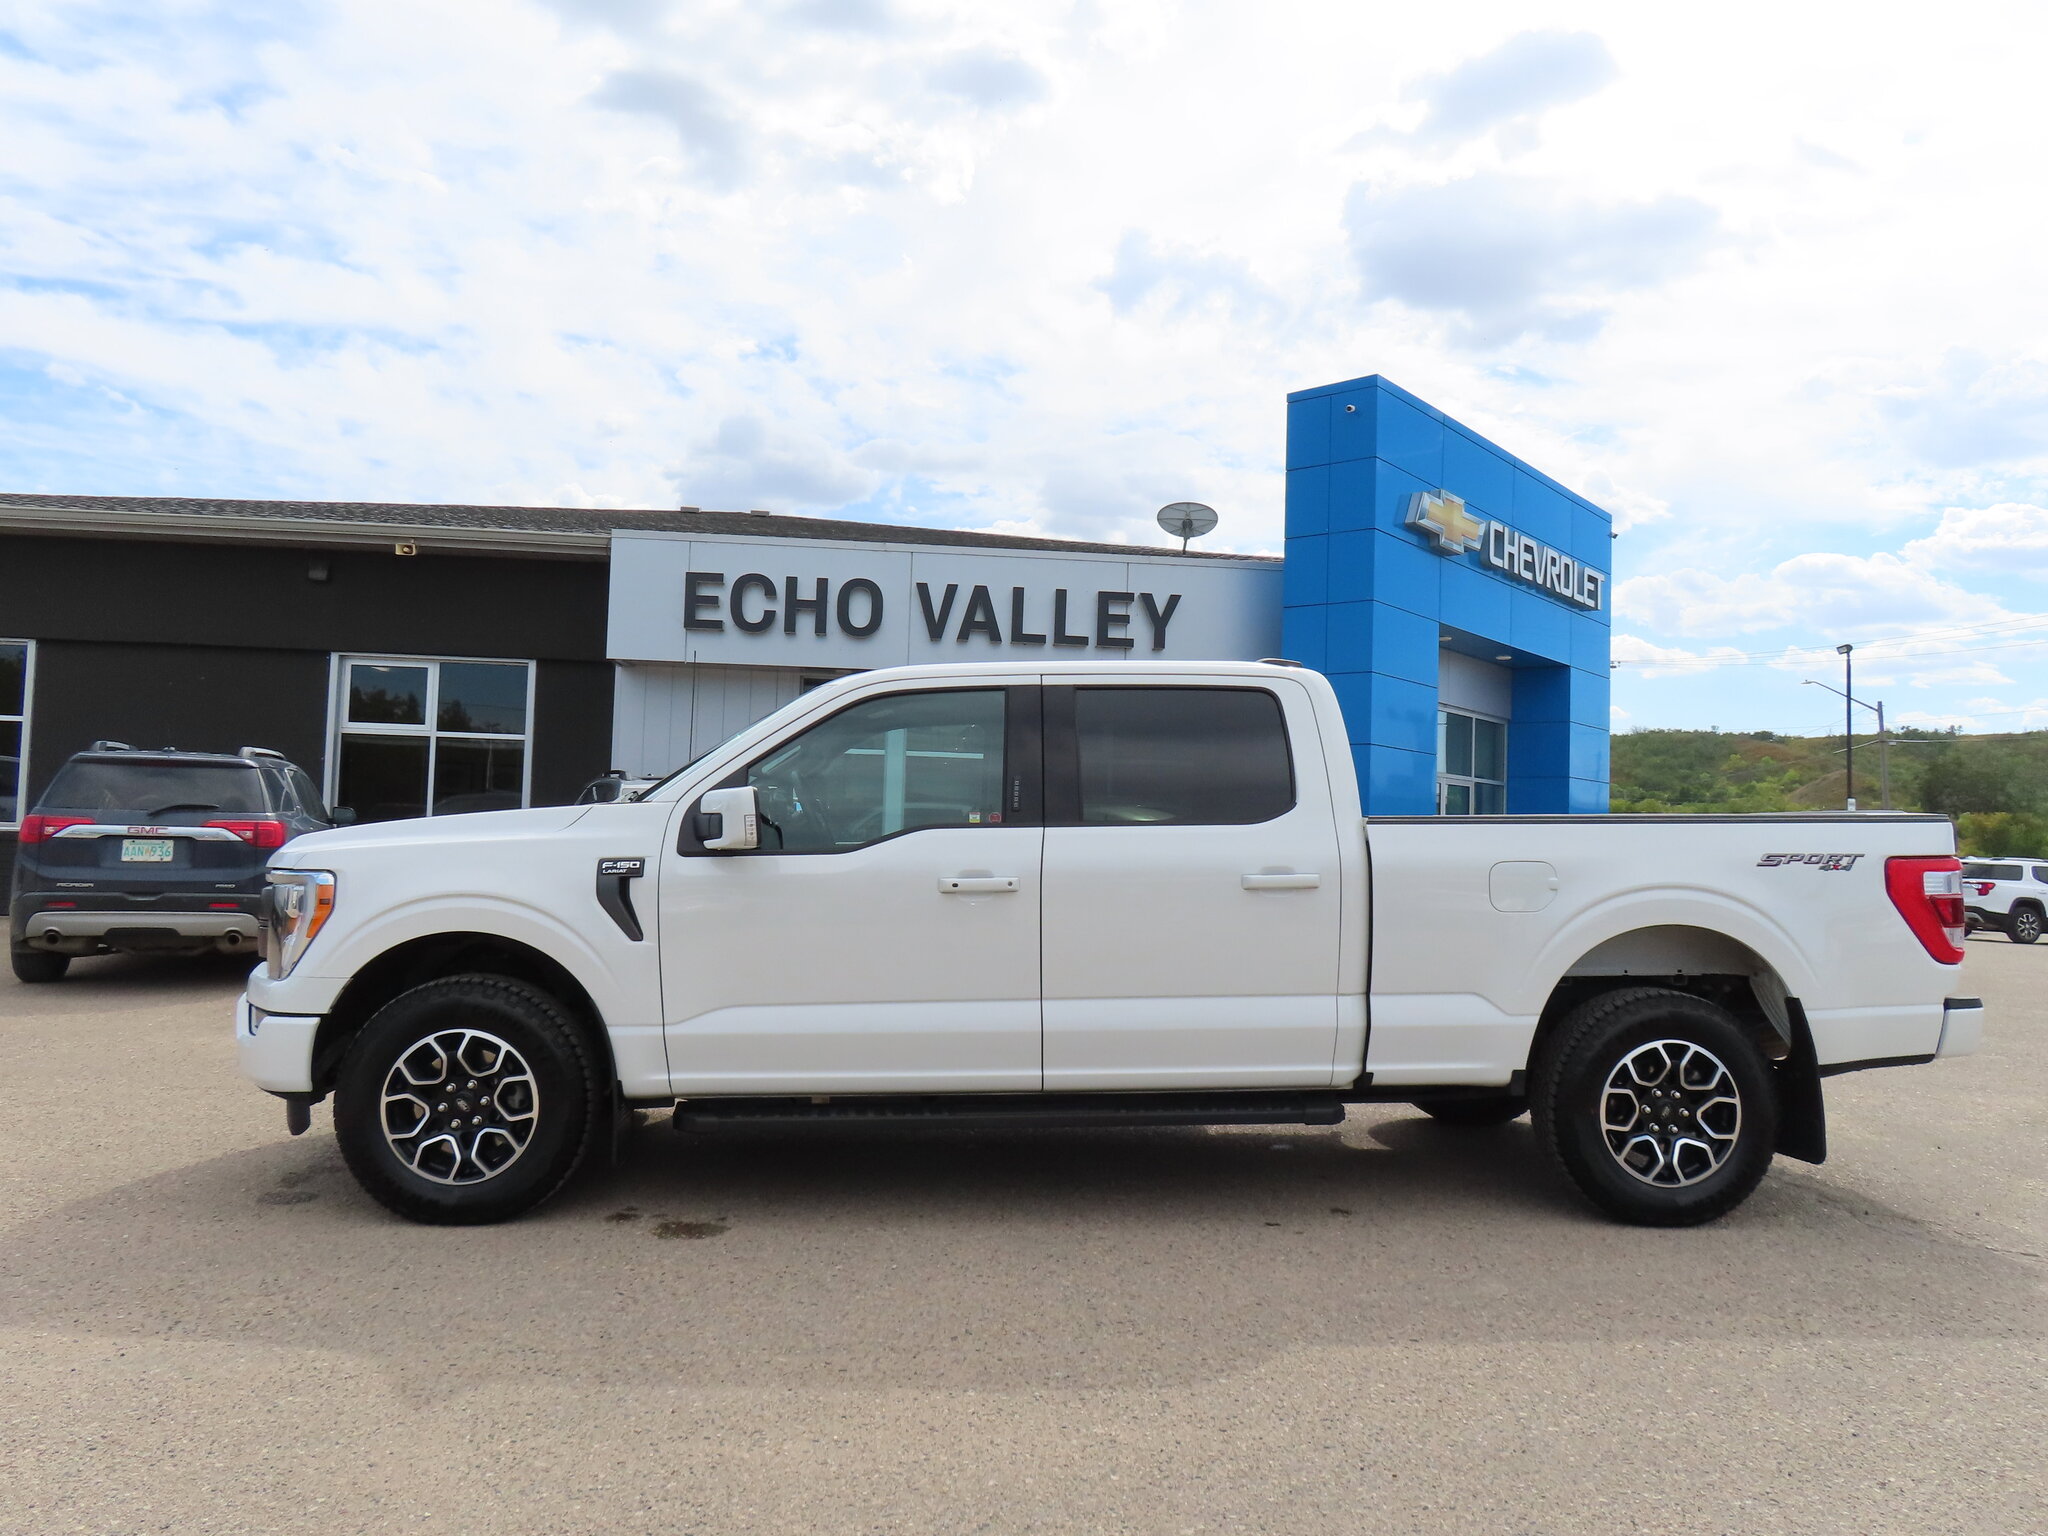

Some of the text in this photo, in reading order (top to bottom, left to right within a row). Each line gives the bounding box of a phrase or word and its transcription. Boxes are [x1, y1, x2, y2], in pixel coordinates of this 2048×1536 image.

[1488, 519, 1605, 611] CHEVROLET
[683, 571, 1183, 651] ECHO VALLEY
[127, 826, 169, 835] GMC
[151, 845, 172, 857] 936
[1756, 853, 1865, 867] SPORT
